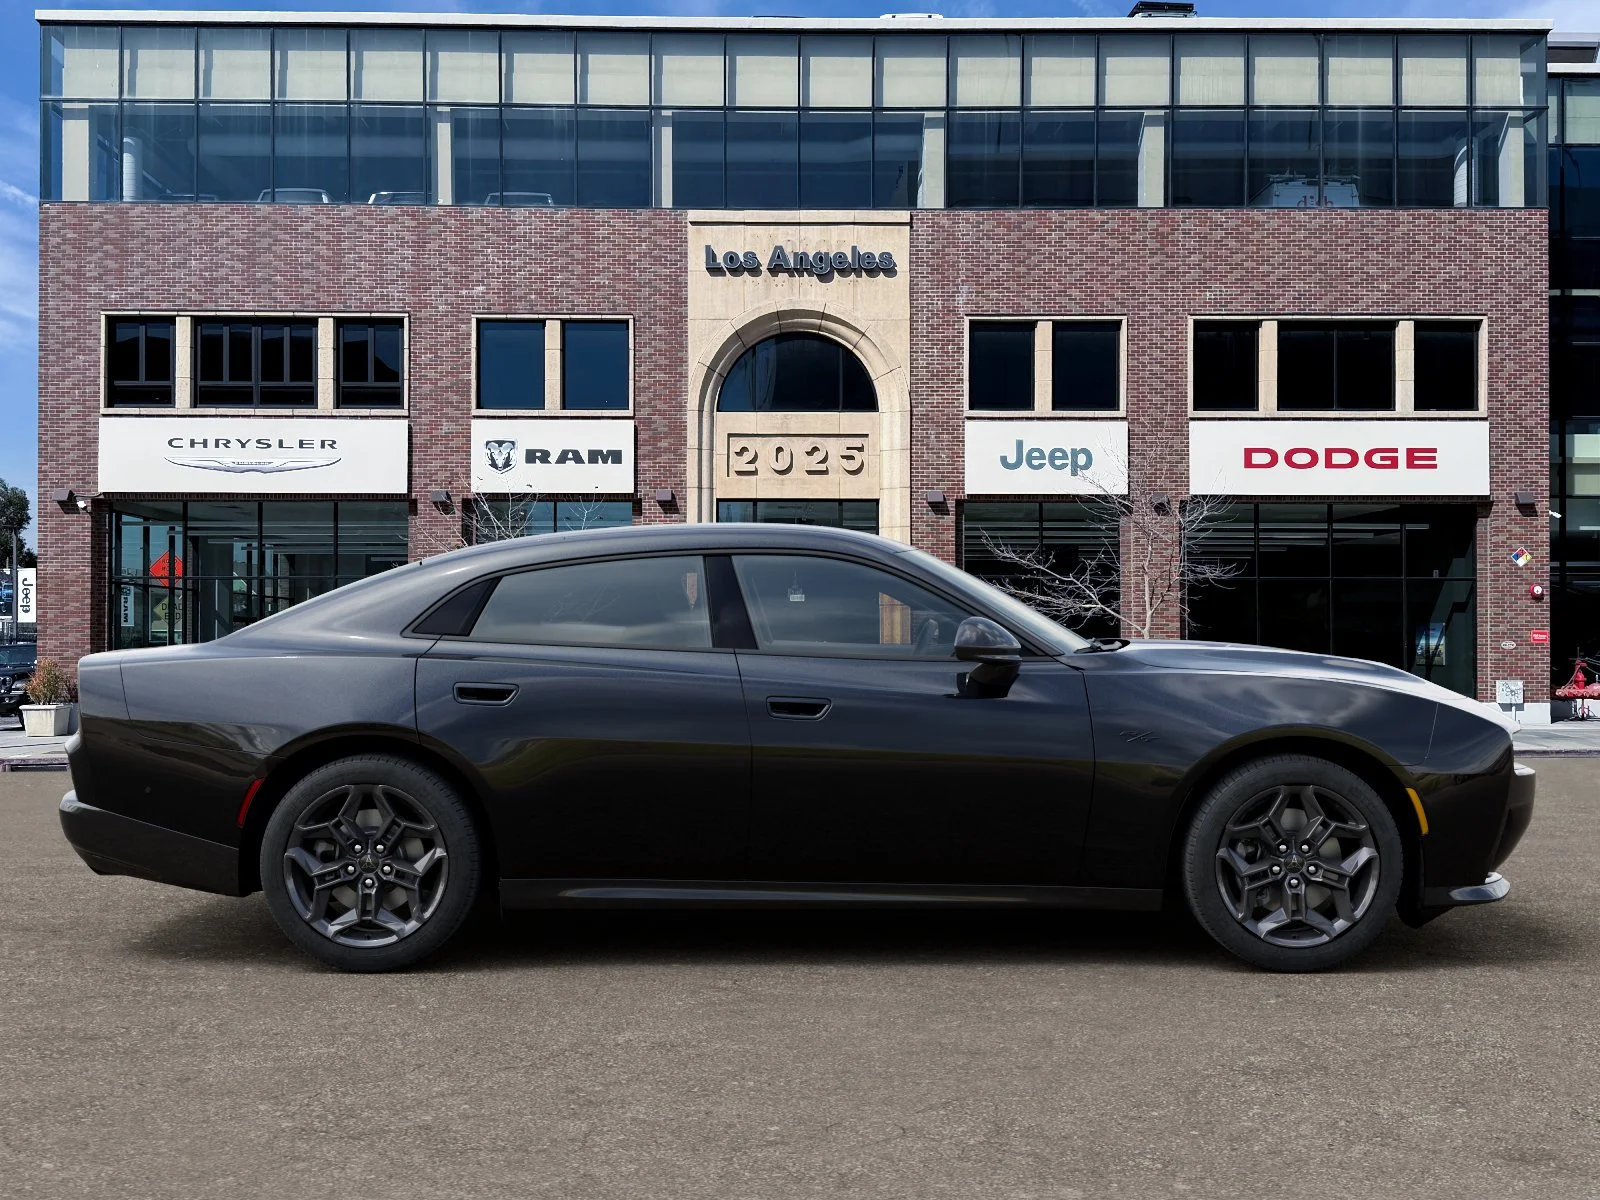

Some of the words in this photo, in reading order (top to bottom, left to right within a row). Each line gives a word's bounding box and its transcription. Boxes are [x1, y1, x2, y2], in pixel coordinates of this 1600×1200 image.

[704, 244, 759, 270] Los
[766, 245, 895, 275] Angeles
[167, 437, 338, 450] CHRYSLER
[525, 449, 623, 465] RAM
[734, 440, 866, 475] 2025
[1000, 439, 1093, 477] Jeep
[1244, 447, 1438, 469] DODGE
[20, 577, 33, 614] Jeep
[165, 612, 181, 620] ED
